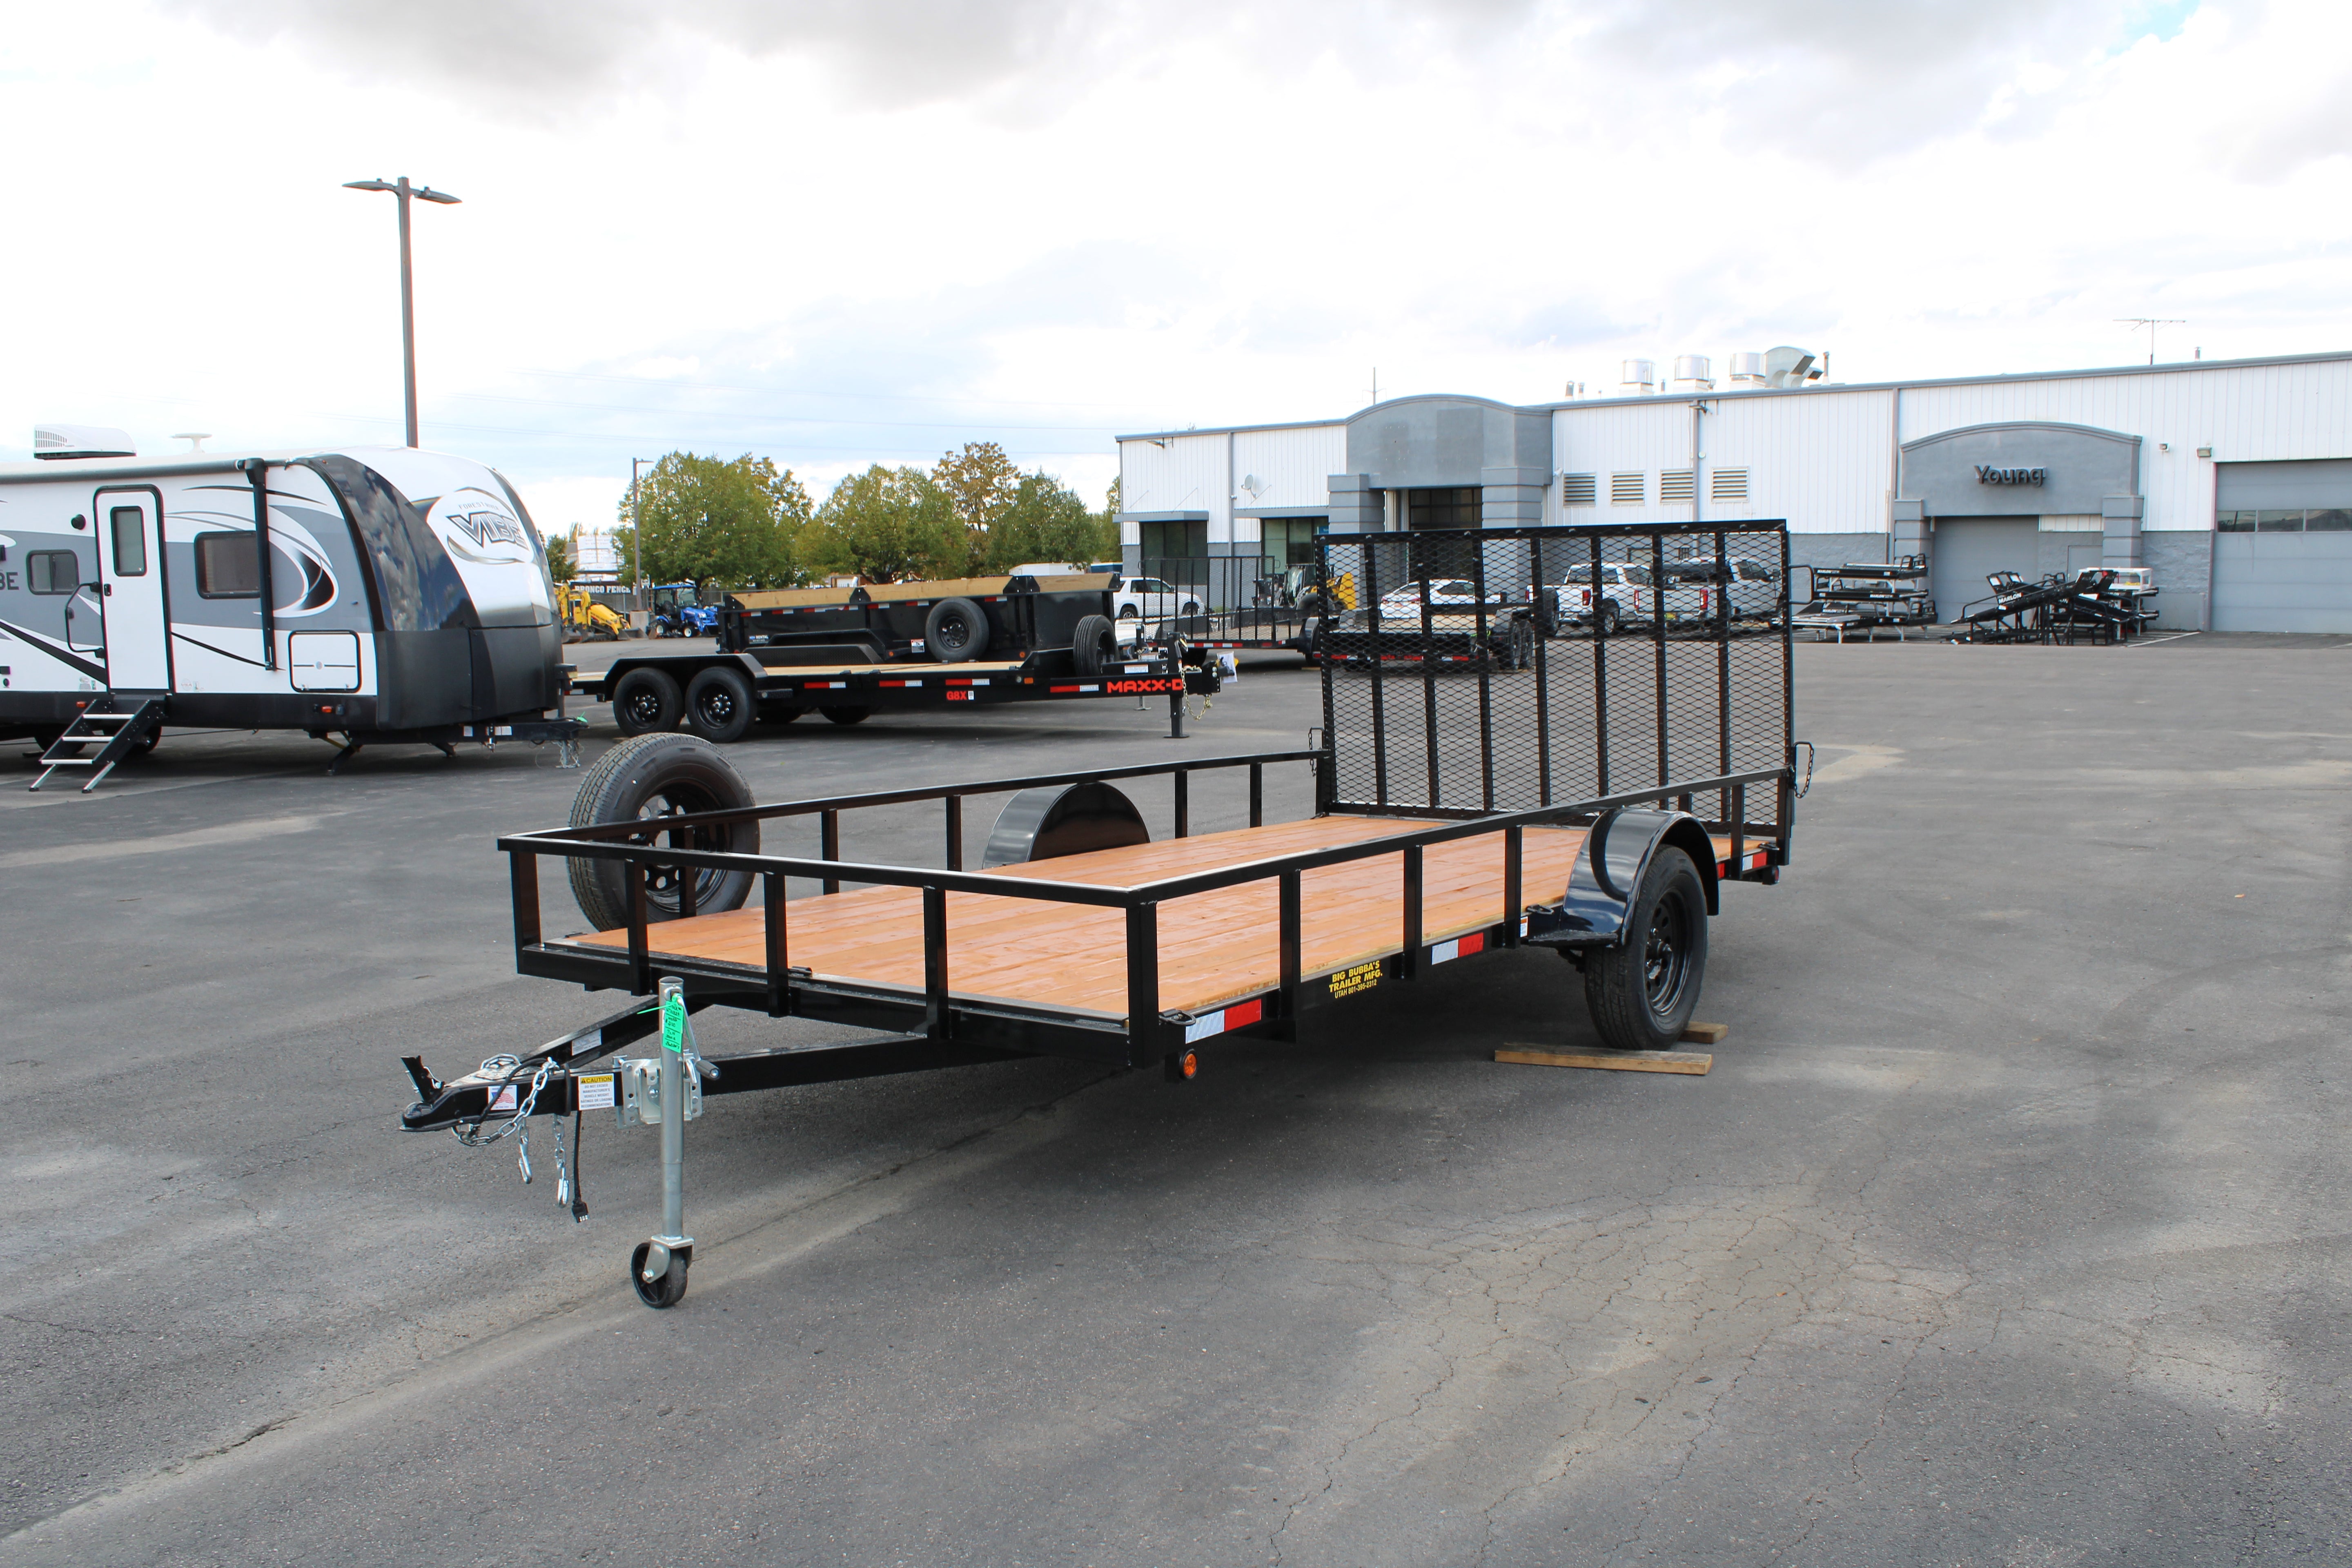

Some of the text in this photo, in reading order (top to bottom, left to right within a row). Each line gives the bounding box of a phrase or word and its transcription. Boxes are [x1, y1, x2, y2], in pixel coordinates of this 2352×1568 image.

[1973, 465, 2043, 487] Young
[459, 501, 485, 510] FOREST
[445, 511, 530, 551] VIBE
[575, 585, 604, 593] BRONCO
[1998, 592, 2022, 604] MARLON
[1107, 679, 1183, 693] MAXX-D
[1329, 969, 1383, 992] TRAILER MFG.
[1332, 960, 1380, 982] BIG BUBBA'S
[1335, 979, 1376, 999] UTAH 801-395-2312
